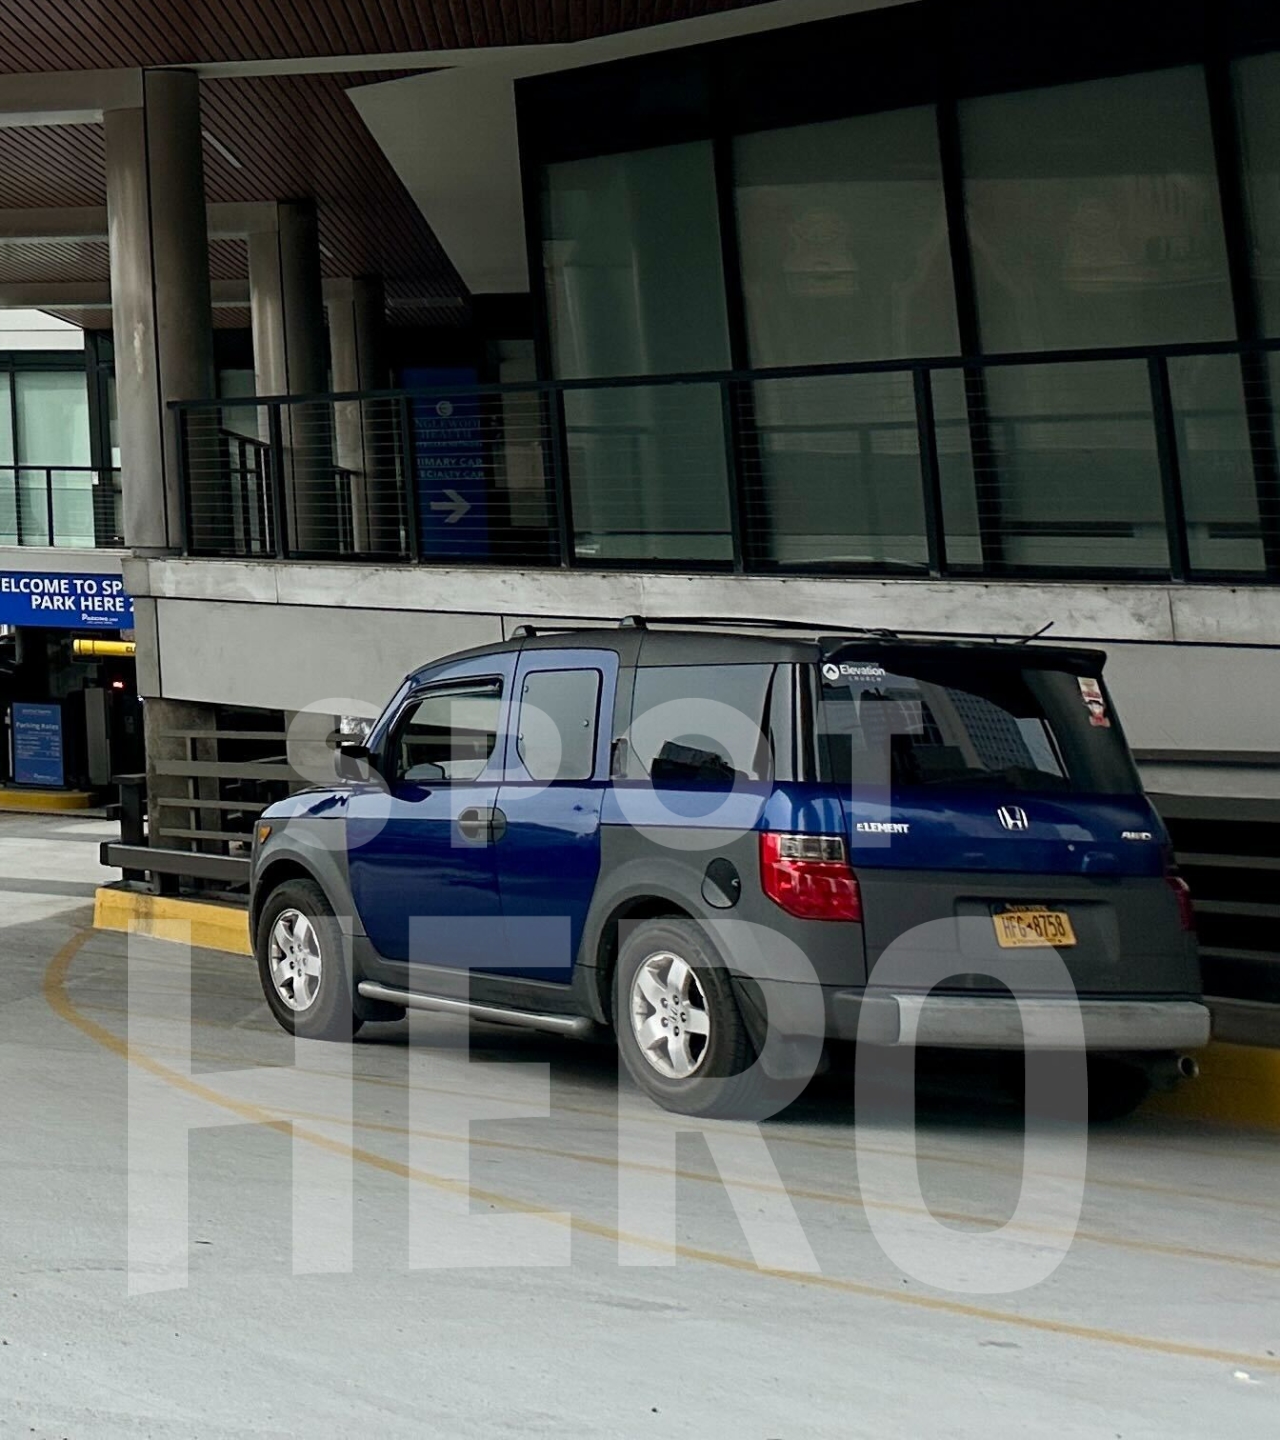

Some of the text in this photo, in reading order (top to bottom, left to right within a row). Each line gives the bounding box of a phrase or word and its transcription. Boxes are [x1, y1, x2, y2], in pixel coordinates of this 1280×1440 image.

[73, 579, 98, 595] TO
[102, 580, 124, 595] SP
[31, 594, 76, 611] PARK
[80, 596, 125, 612] HERE
[838, 664, 887, 677] Elevation
[856, 821, 910, 834] ELEMENT
